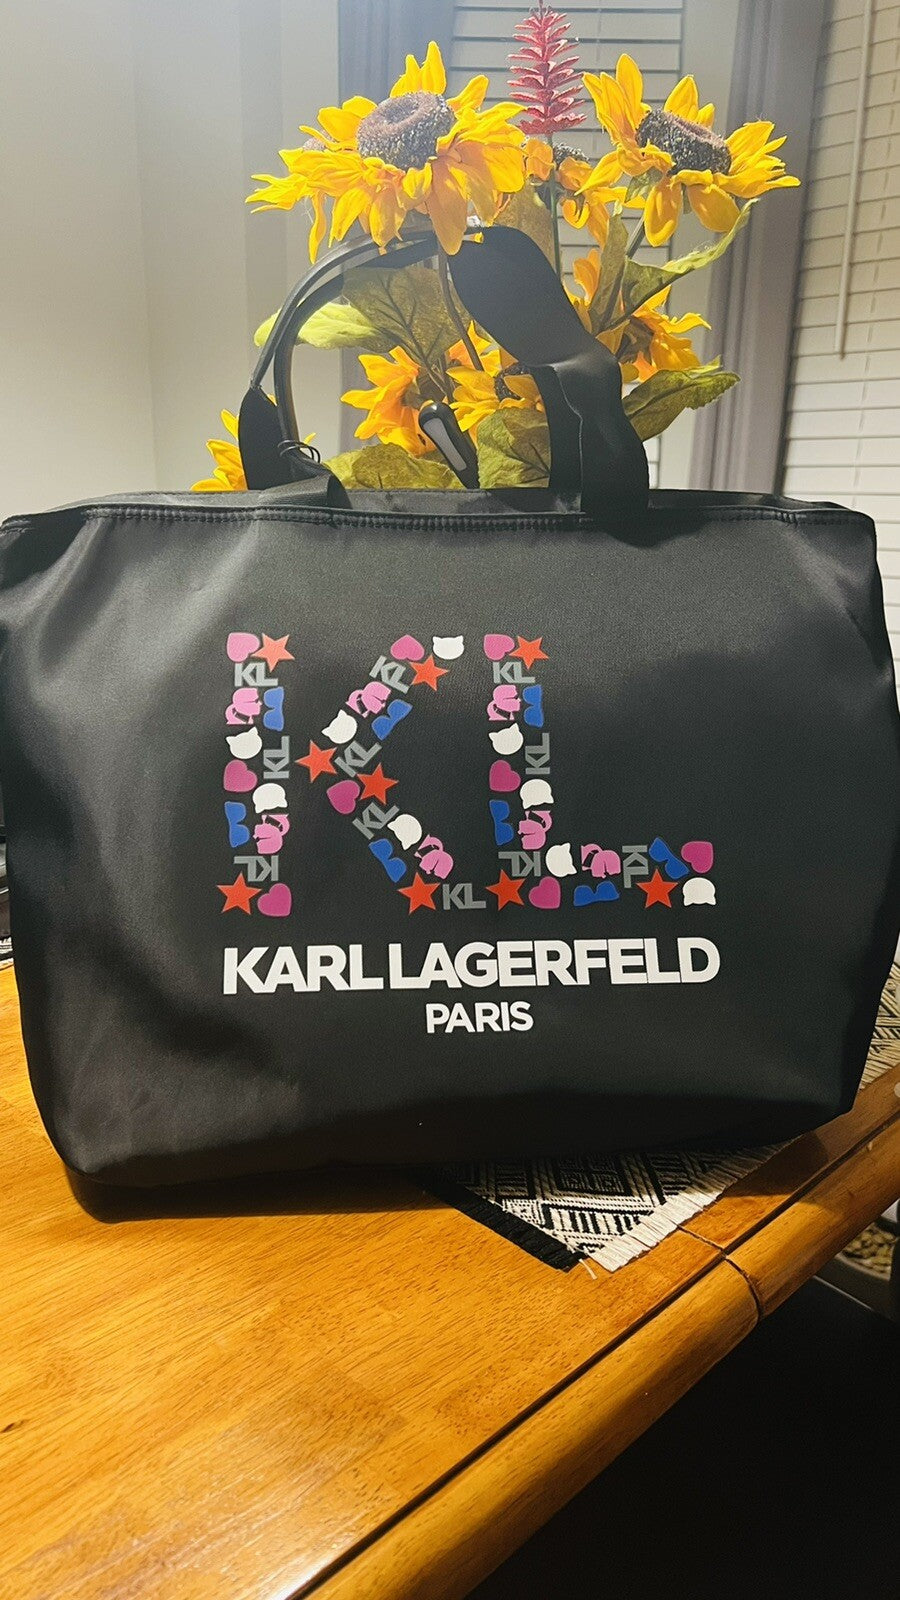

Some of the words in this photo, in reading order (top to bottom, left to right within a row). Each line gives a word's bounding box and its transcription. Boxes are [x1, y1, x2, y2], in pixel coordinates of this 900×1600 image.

[234, 661, 279, 687] KL
[369, 655, 411, 694] KL
[492, 661, 536, 684] KL
[263, 735, 290, 779] KL
[334, 740, 383, 778] KL
[525, 732, 550, 775] KL
[352, 802, 400, 840] KL
[233, 854, 279, 882] KL
[498, 850, 541, 877] KL
[622, 844, 649, 889] KL
[442, 882, 487, 911] KL
[223, 943, 384, 995] KARL
[389, 937, 721, 989] LAGERFELD
[425, 1001, 534, 1034] PARIS
